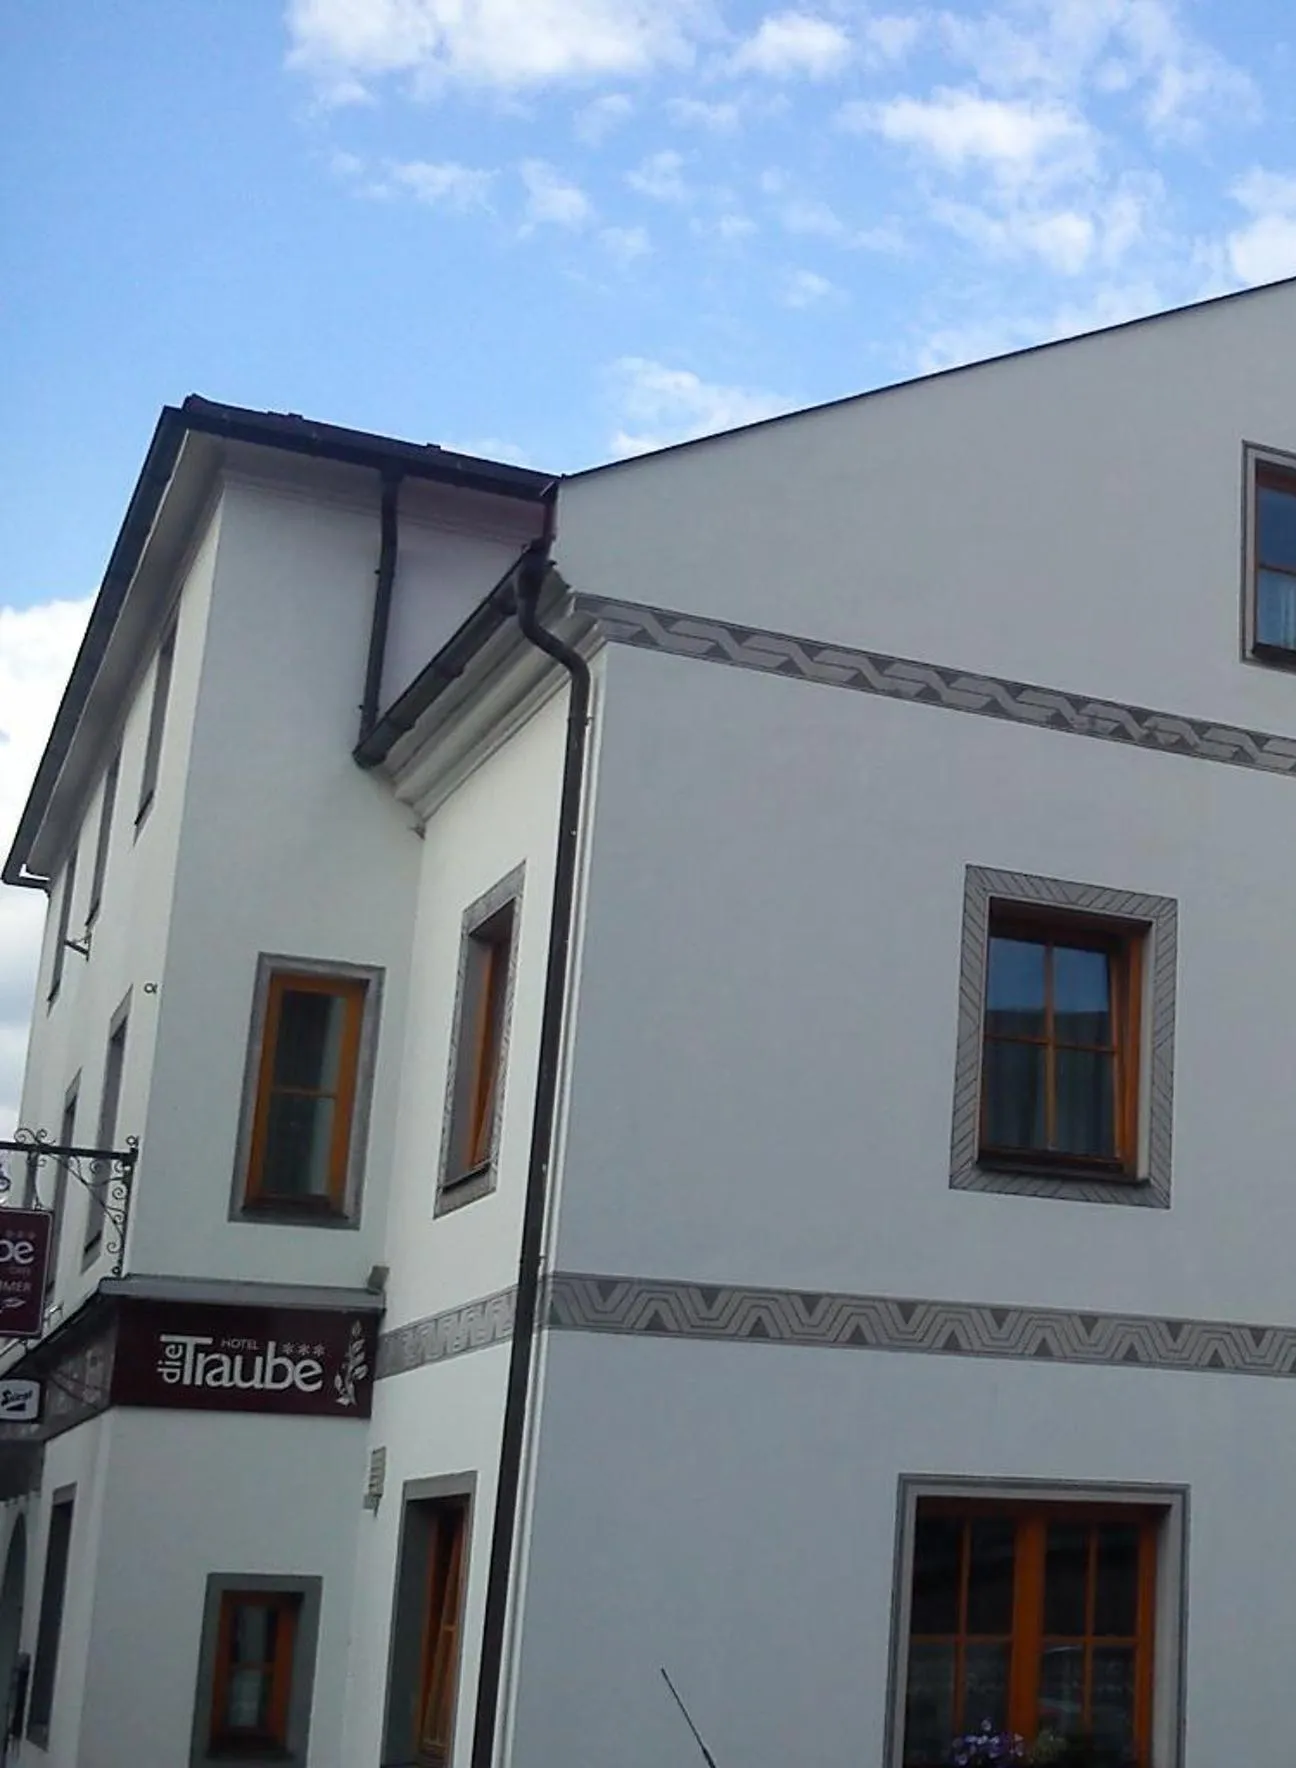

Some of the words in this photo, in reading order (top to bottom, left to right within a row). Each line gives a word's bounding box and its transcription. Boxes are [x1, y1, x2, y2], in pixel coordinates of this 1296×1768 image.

[157, 1343, 183, 1384] die
[160, 1334, 324, 1392] Traube
[220, 1338, 259, 1350] HOTEL
